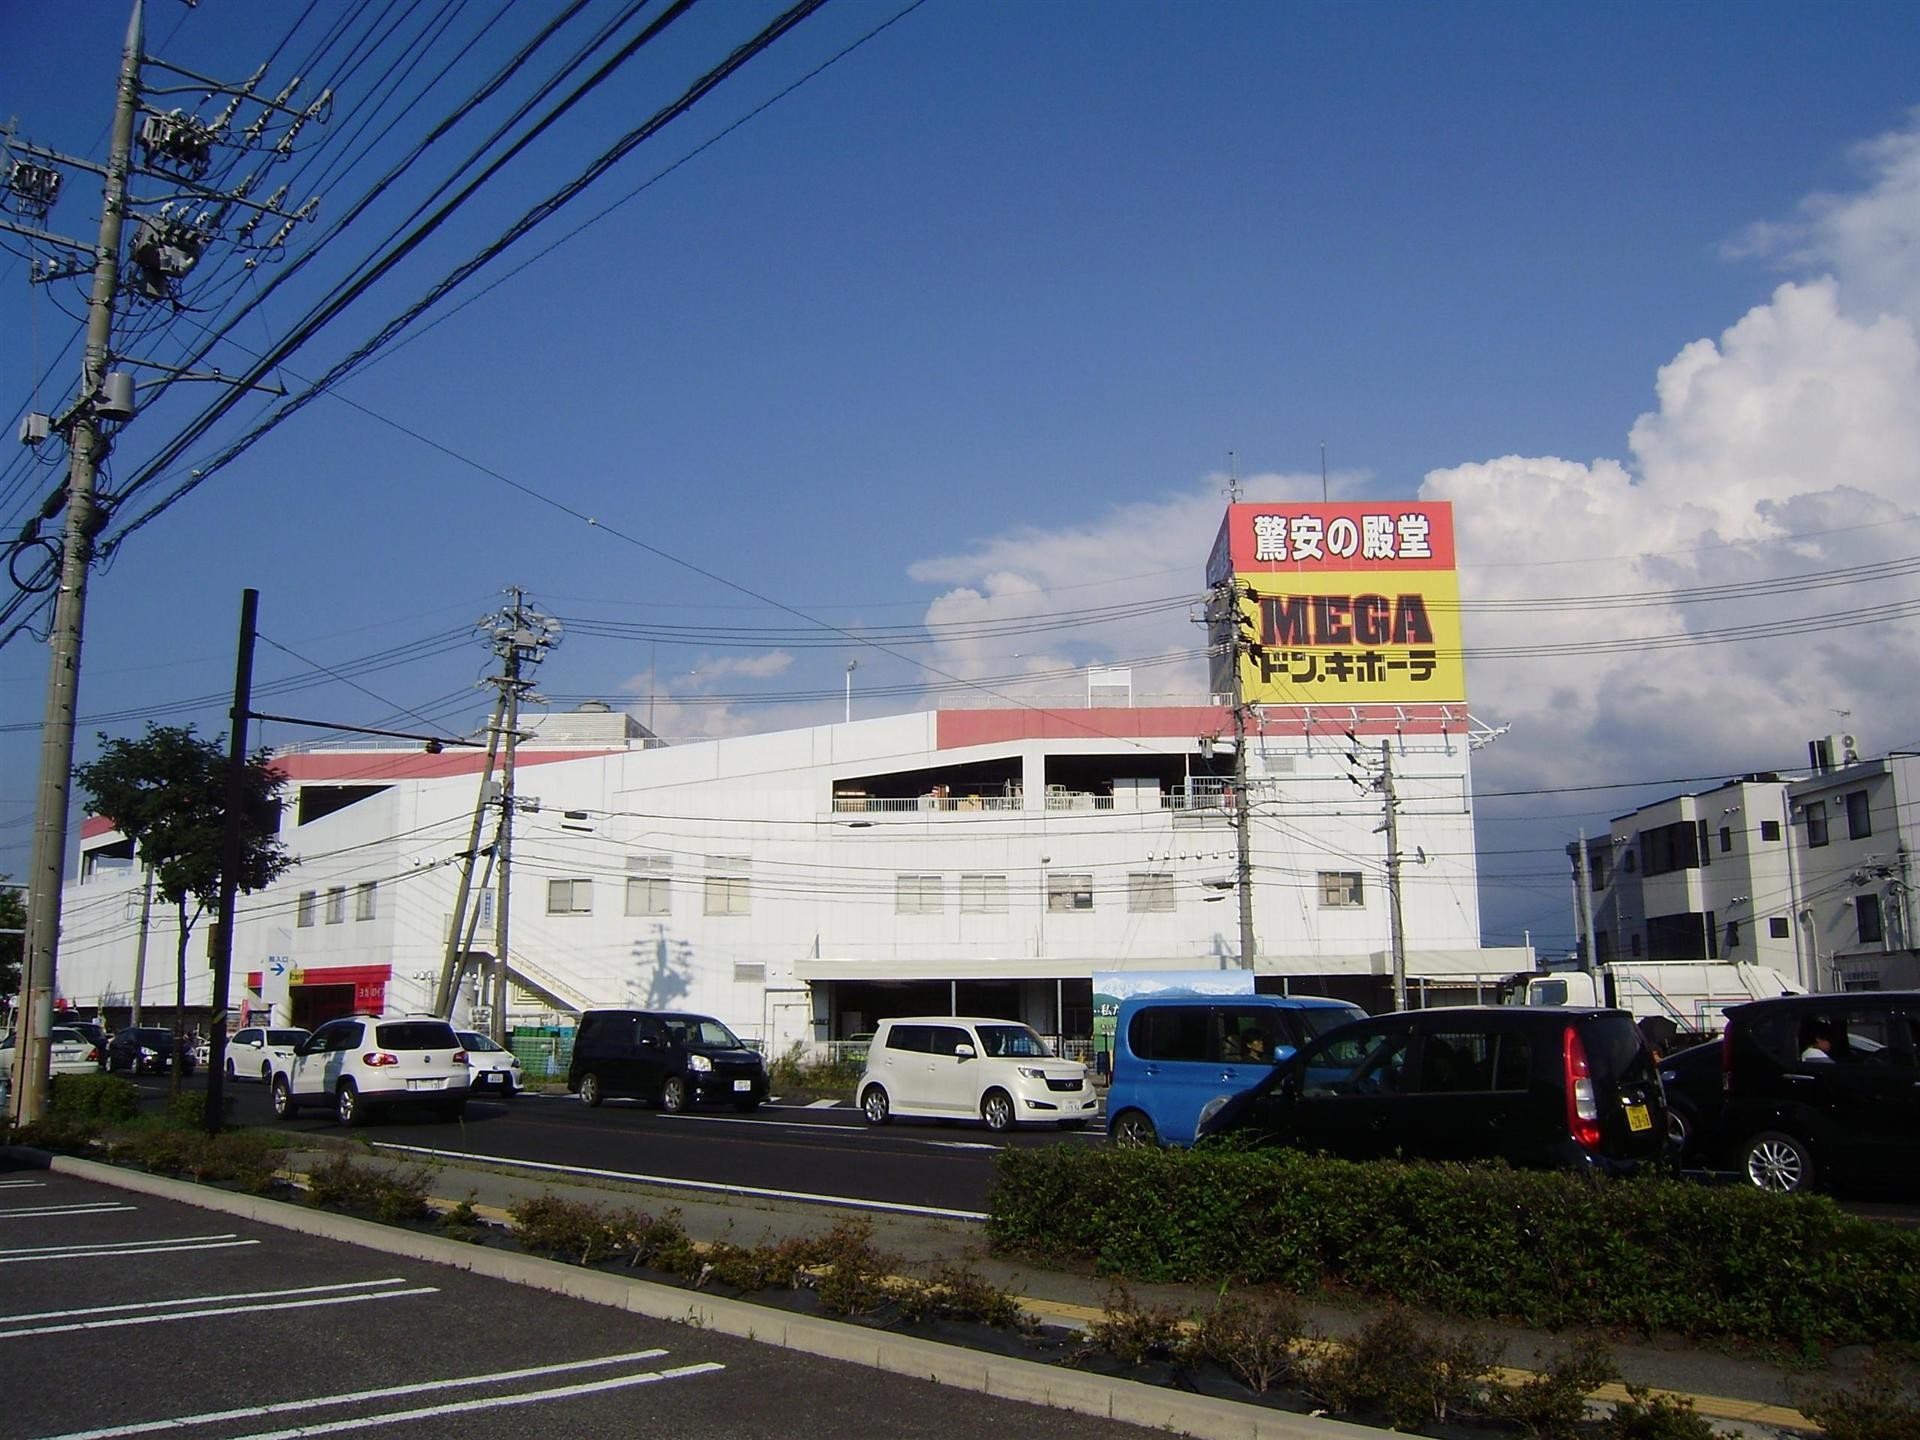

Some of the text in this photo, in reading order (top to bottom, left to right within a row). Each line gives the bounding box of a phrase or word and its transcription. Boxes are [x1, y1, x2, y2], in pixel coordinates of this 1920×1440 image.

[1254, 514, 1432, 561] 驚安の殿堂
[1258, 593, 1435, 646] MEGA
